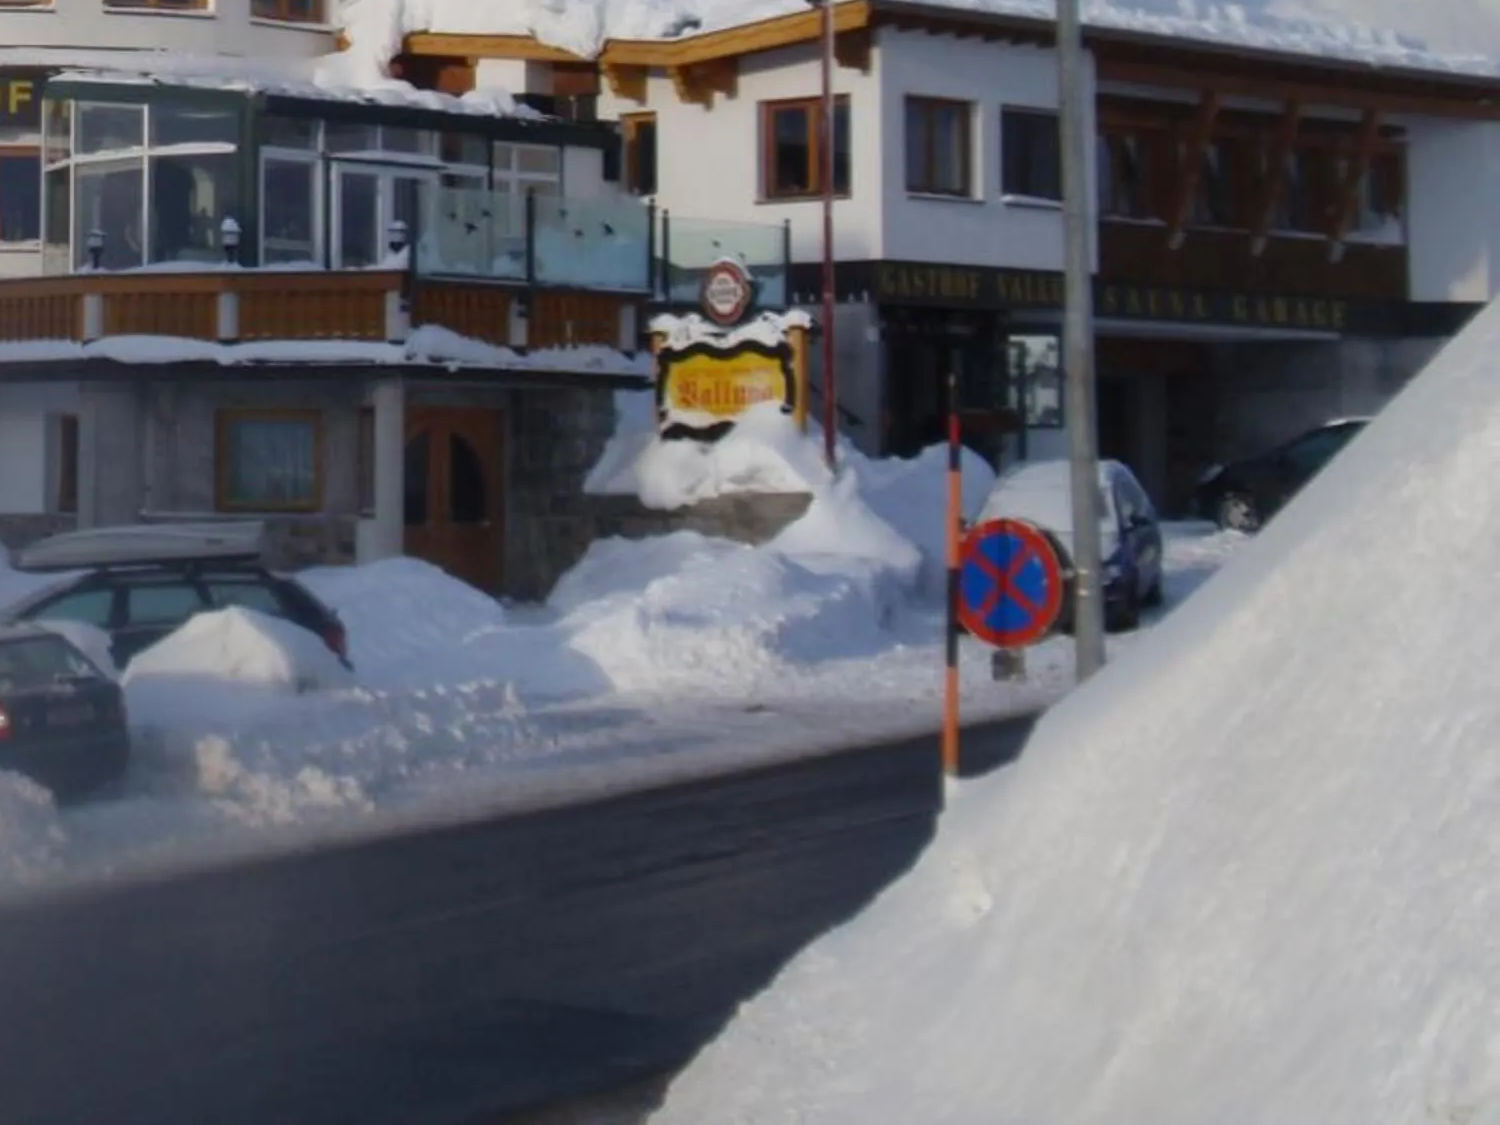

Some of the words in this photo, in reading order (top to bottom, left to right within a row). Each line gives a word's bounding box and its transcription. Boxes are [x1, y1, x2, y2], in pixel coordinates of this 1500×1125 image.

[880, 268, 981, 299] GASTHOF
[1102, 284, 1209, 318] SAUNA
[1231, 292, 1347, 328] GARAGE
